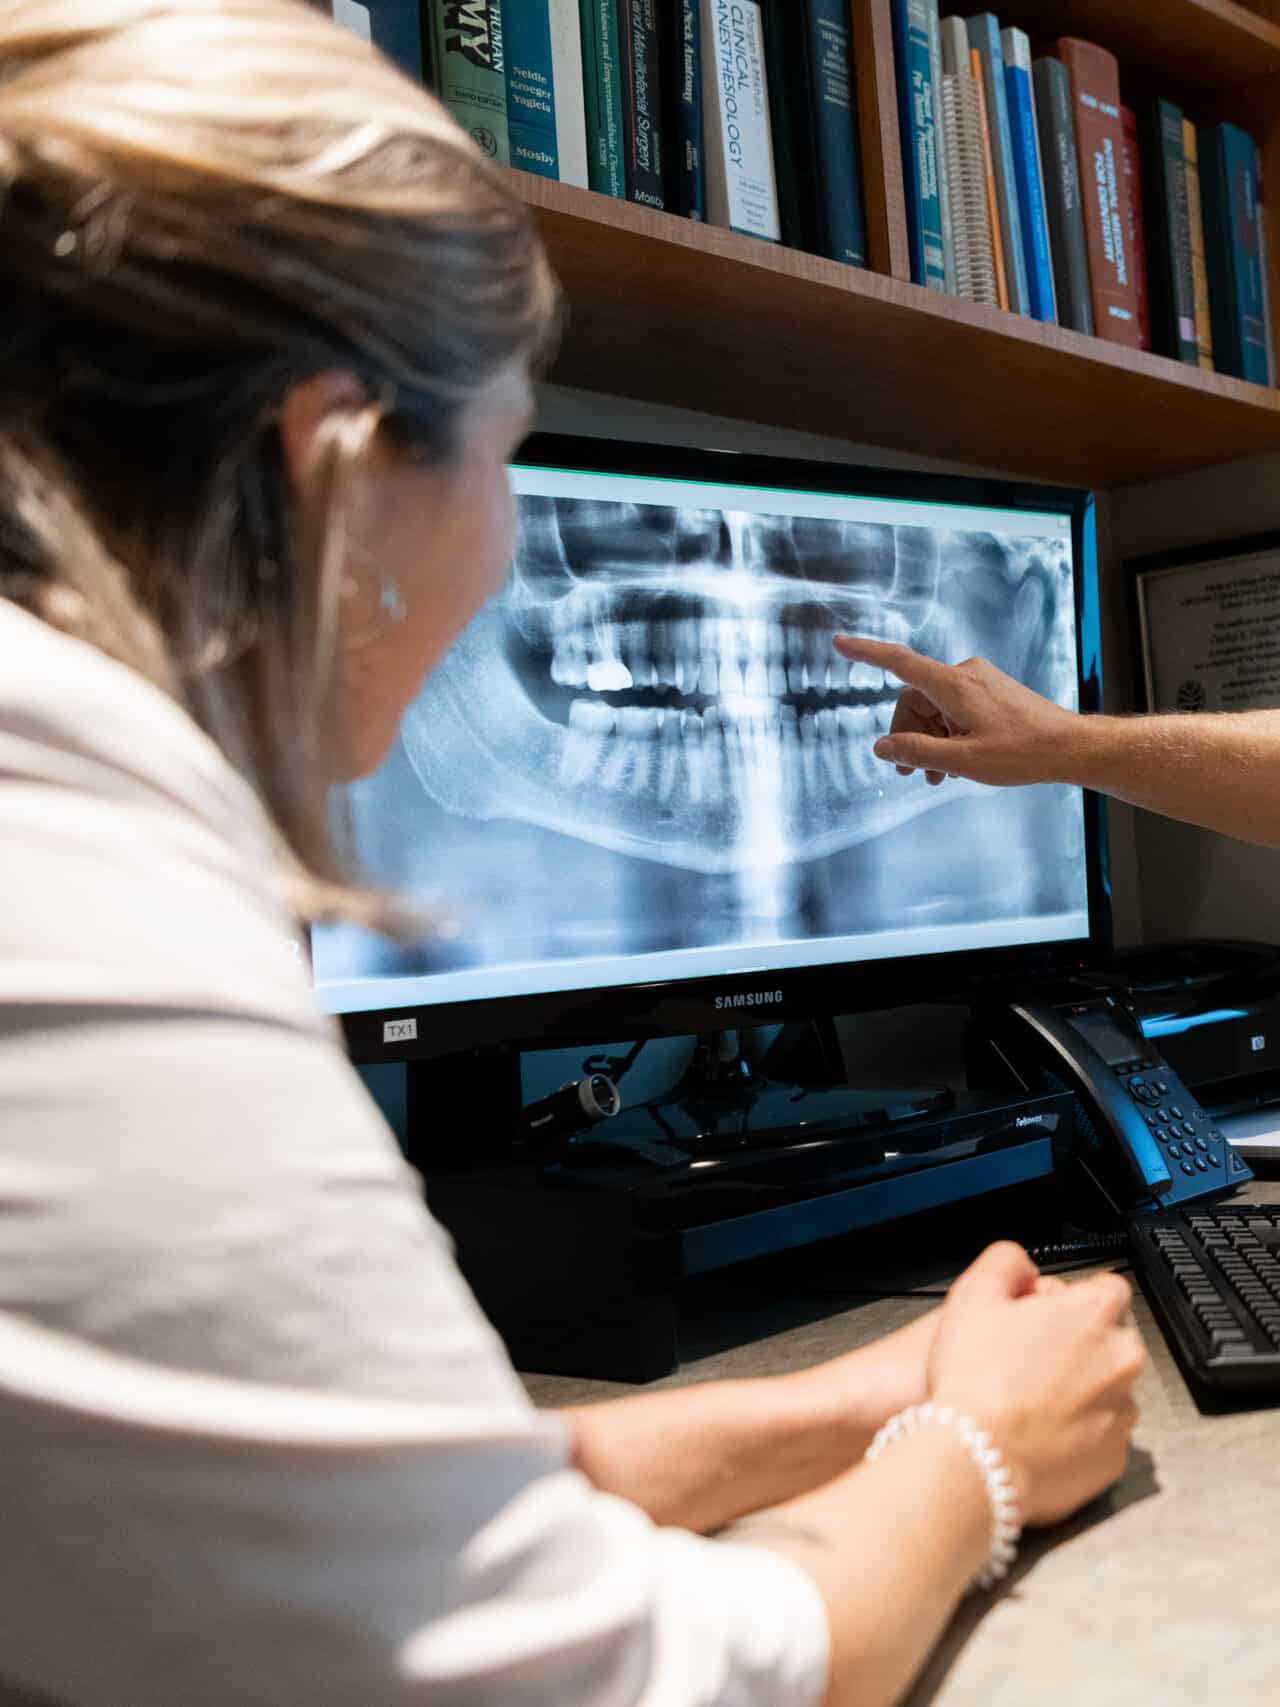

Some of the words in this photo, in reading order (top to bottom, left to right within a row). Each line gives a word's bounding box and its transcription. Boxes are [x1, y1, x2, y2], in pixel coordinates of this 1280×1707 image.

[489, 8, 504, 73] HUMAN
[683, 9, 693, 41] Neck
[731, 5, 749, 90] CLINICAL
[634, 30, 649, 117] Maxillofacial
[682, 43, 694, 104] Anatomy
[718, 0, 743, 169] ANESTHESIOLOGY
[516, 146, 554, 166] Mosby
[636, 115, 650, 172] Surgery
[634, 189, 664, 208] Mosby
[1098, 184, 1115, 263] DENTISTRY
[1103, 138, 1118, 209] INTERNAL
[1112, 212, 1128, 285] MEDICINE
[387, 1023, 412, 1037] TX1
[715, 990, 783, 1009] SAMSUNG
